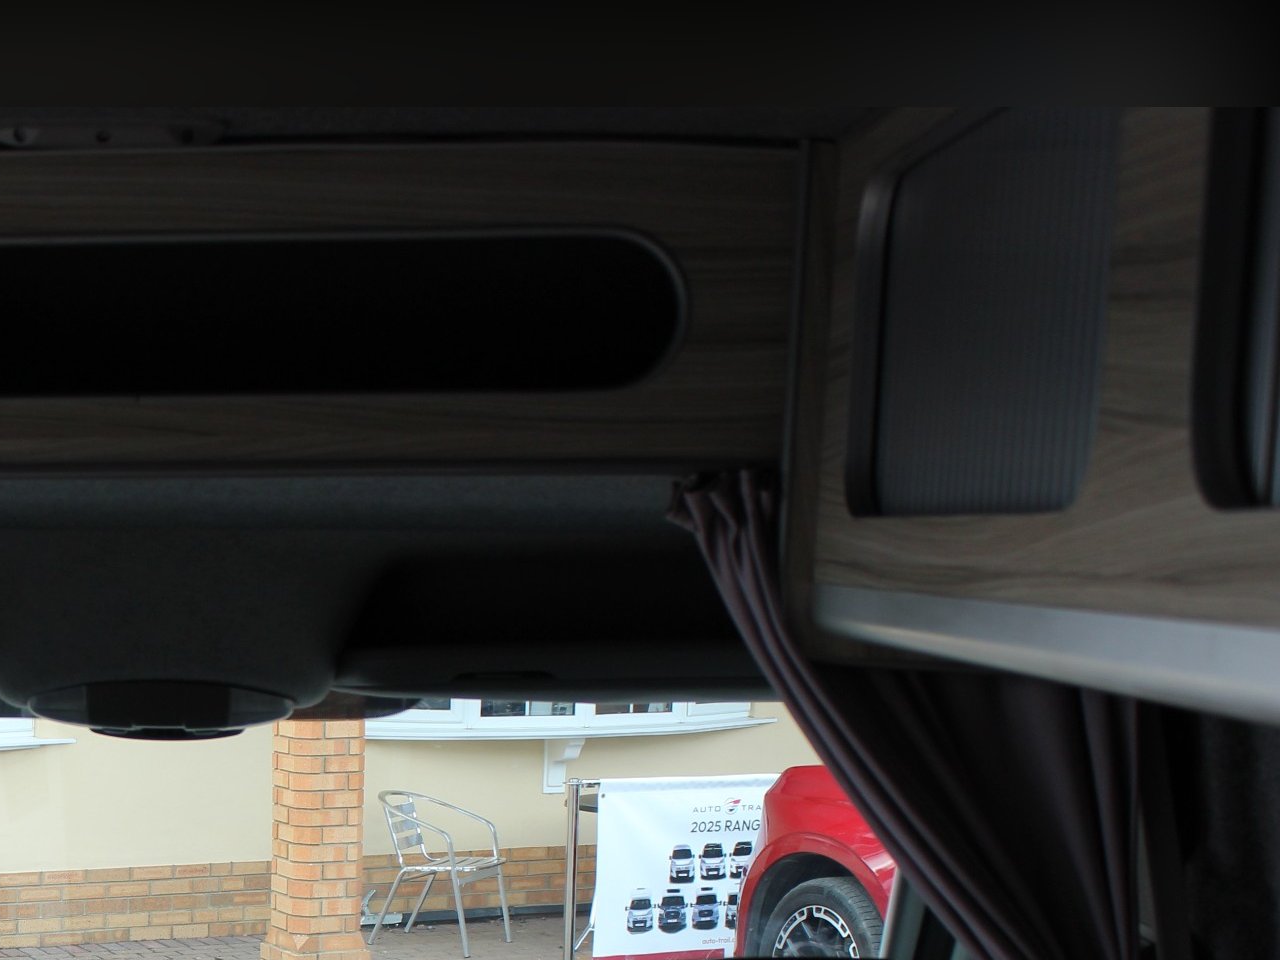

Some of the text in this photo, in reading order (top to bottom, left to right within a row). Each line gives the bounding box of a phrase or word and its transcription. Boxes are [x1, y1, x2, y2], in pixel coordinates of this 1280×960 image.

[692, 805, 722, 813] AUTO
[690, 819, 761, 833] 2025 RANG
